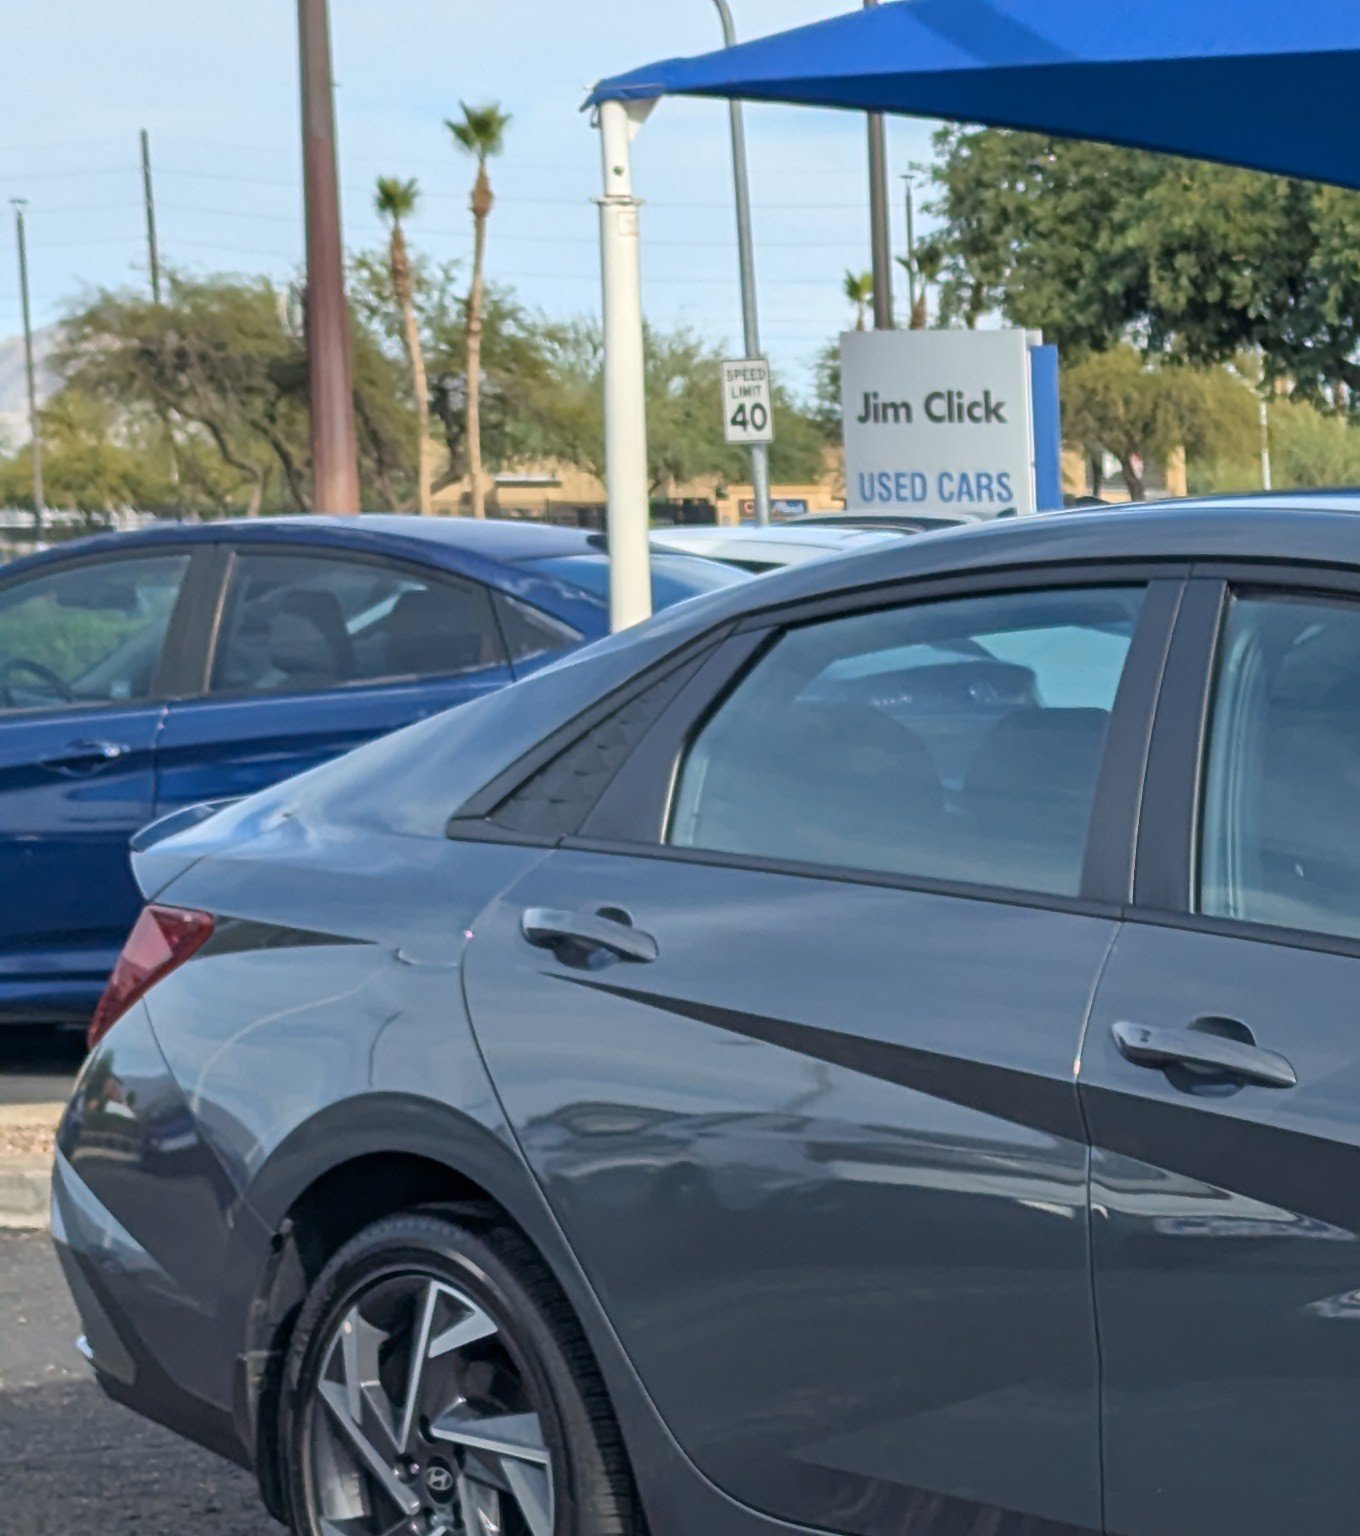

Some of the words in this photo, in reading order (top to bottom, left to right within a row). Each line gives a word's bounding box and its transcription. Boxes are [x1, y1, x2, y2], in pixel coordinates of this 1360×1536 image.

[726, 368, 765, 382] SPEED
[731, 385, 761, 398] LIMIT
[730, 403, 767, 432] 40
[857, 391, 912, 424] Jim
[924, 390, 1008, 424] Click
[858, 472, 928, 502] USED
[938, 471, 1014, 502] CARS
